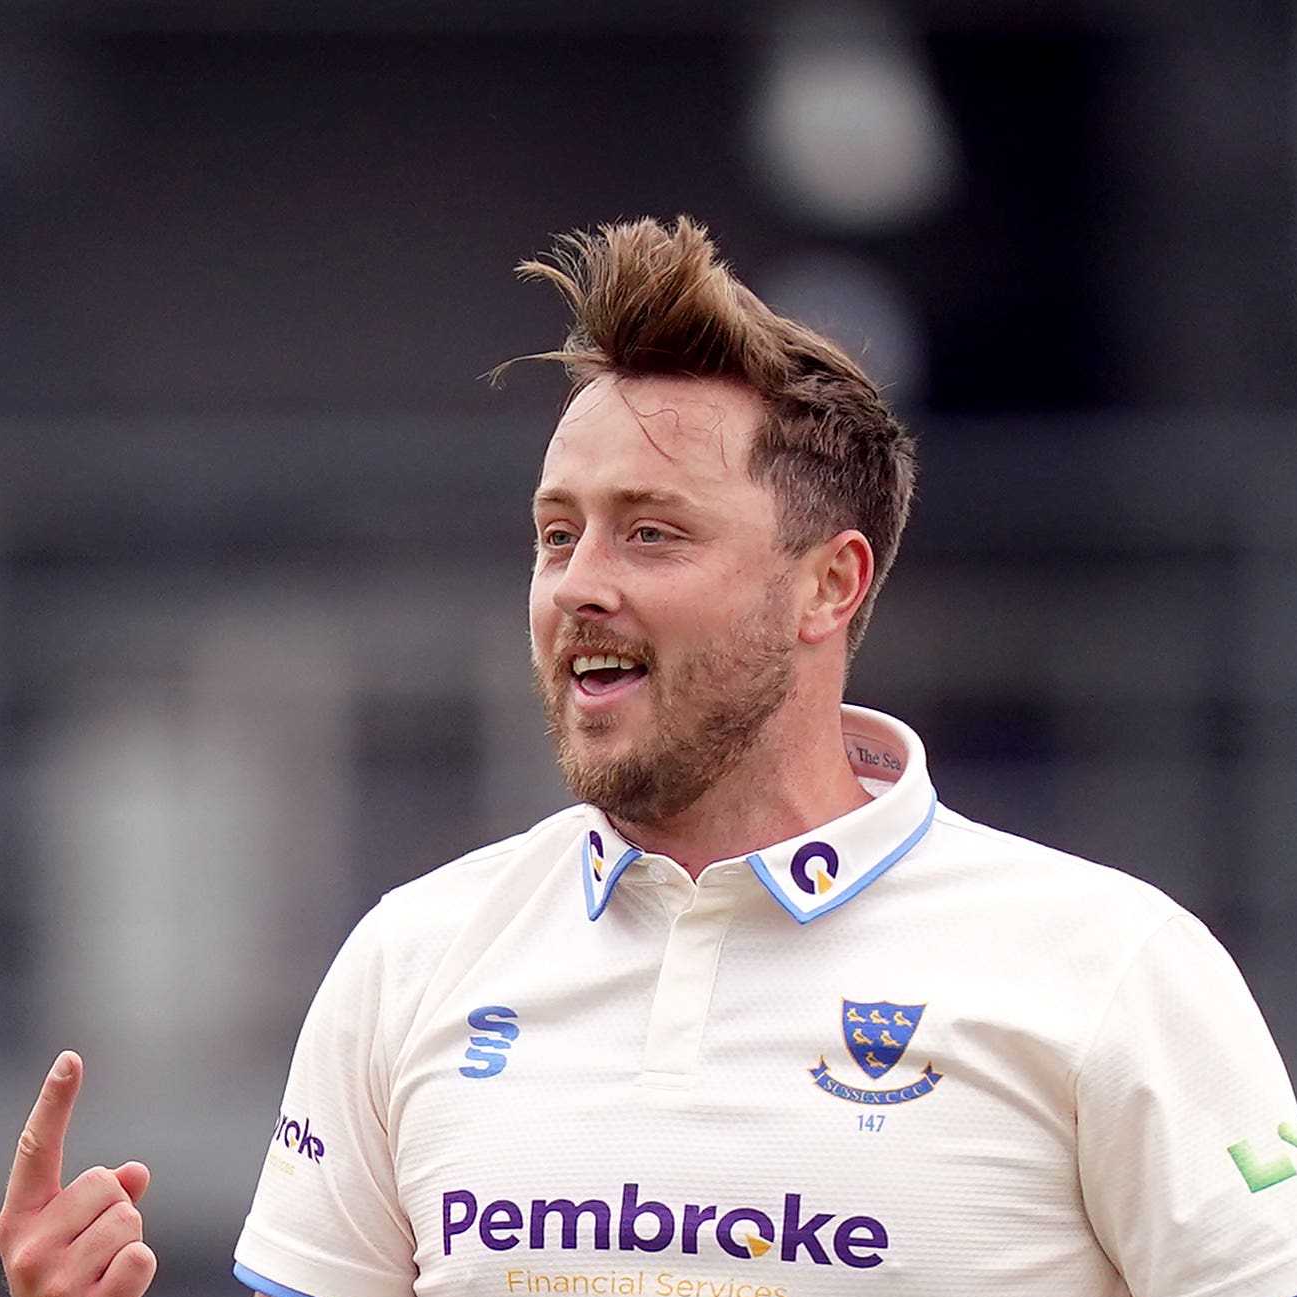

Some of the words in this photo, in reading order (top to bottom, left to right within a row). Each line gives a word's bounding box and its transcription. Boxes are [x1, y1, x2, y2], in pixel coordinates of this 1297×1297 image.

[856, 746, 879, 766] The
[857, 1114, 886, 1132] 147
[442, 1183, 889, 1269] Pembroke
[507, 1270, 644, 1296] Financial
